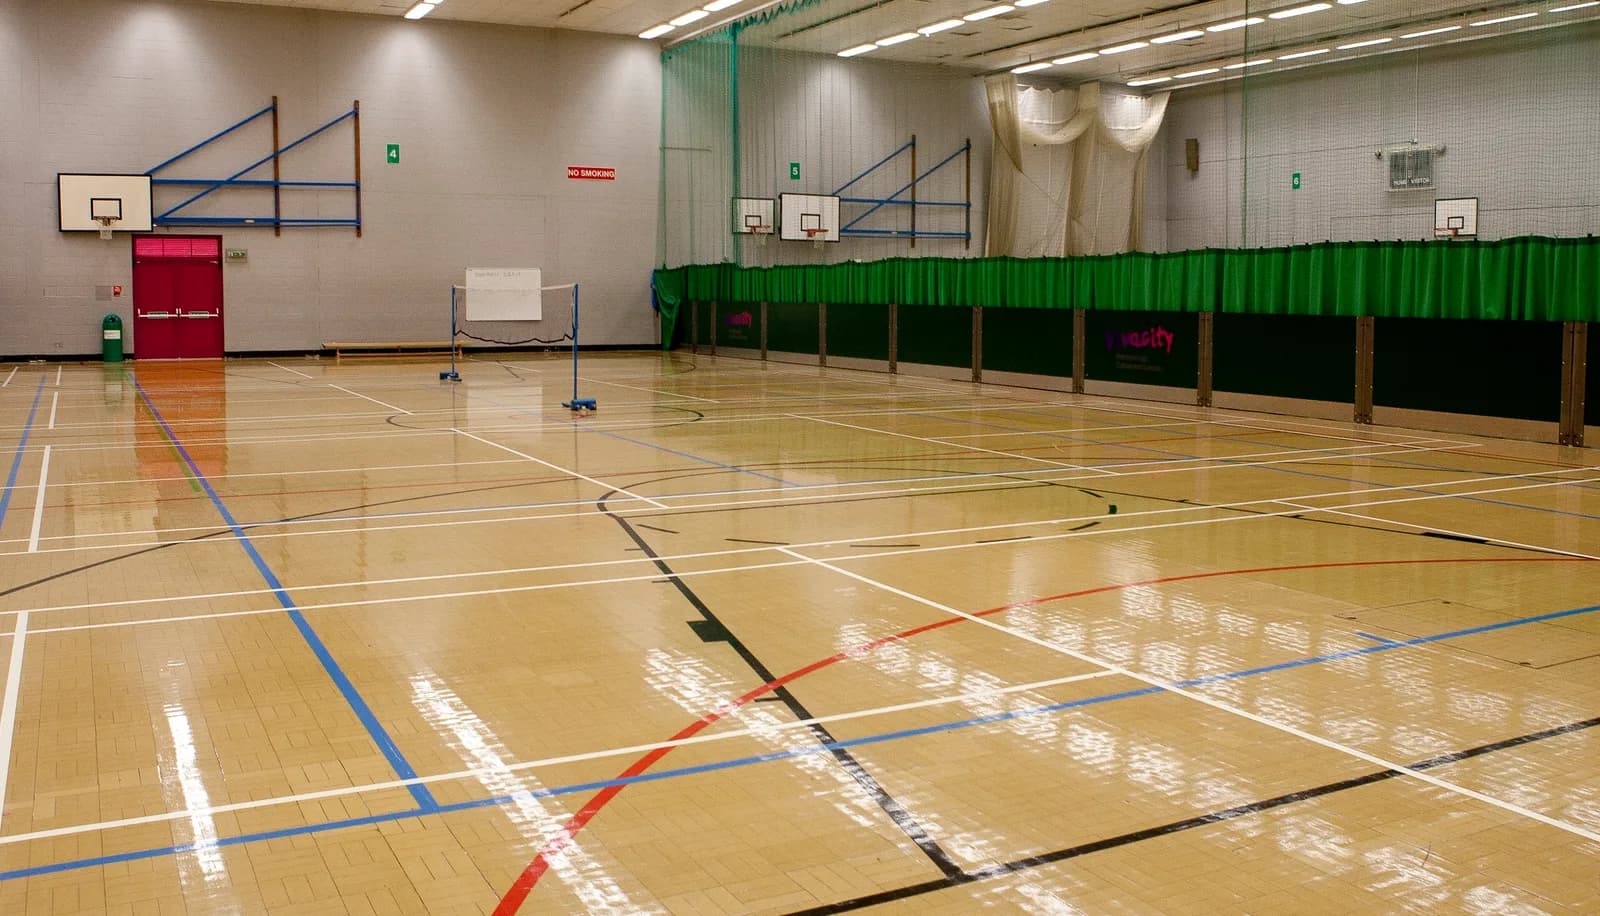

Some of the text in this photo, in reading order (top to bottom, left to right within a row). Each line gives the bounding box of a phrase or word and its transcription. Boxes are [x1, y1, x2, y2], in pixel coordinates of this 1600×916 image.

[390, 149, 397, 158] 4
[568, 168, 615, 178] NO SMOKING
[792, 166, 799, 176] 5
[1293, 177, 1299, 185] 6
